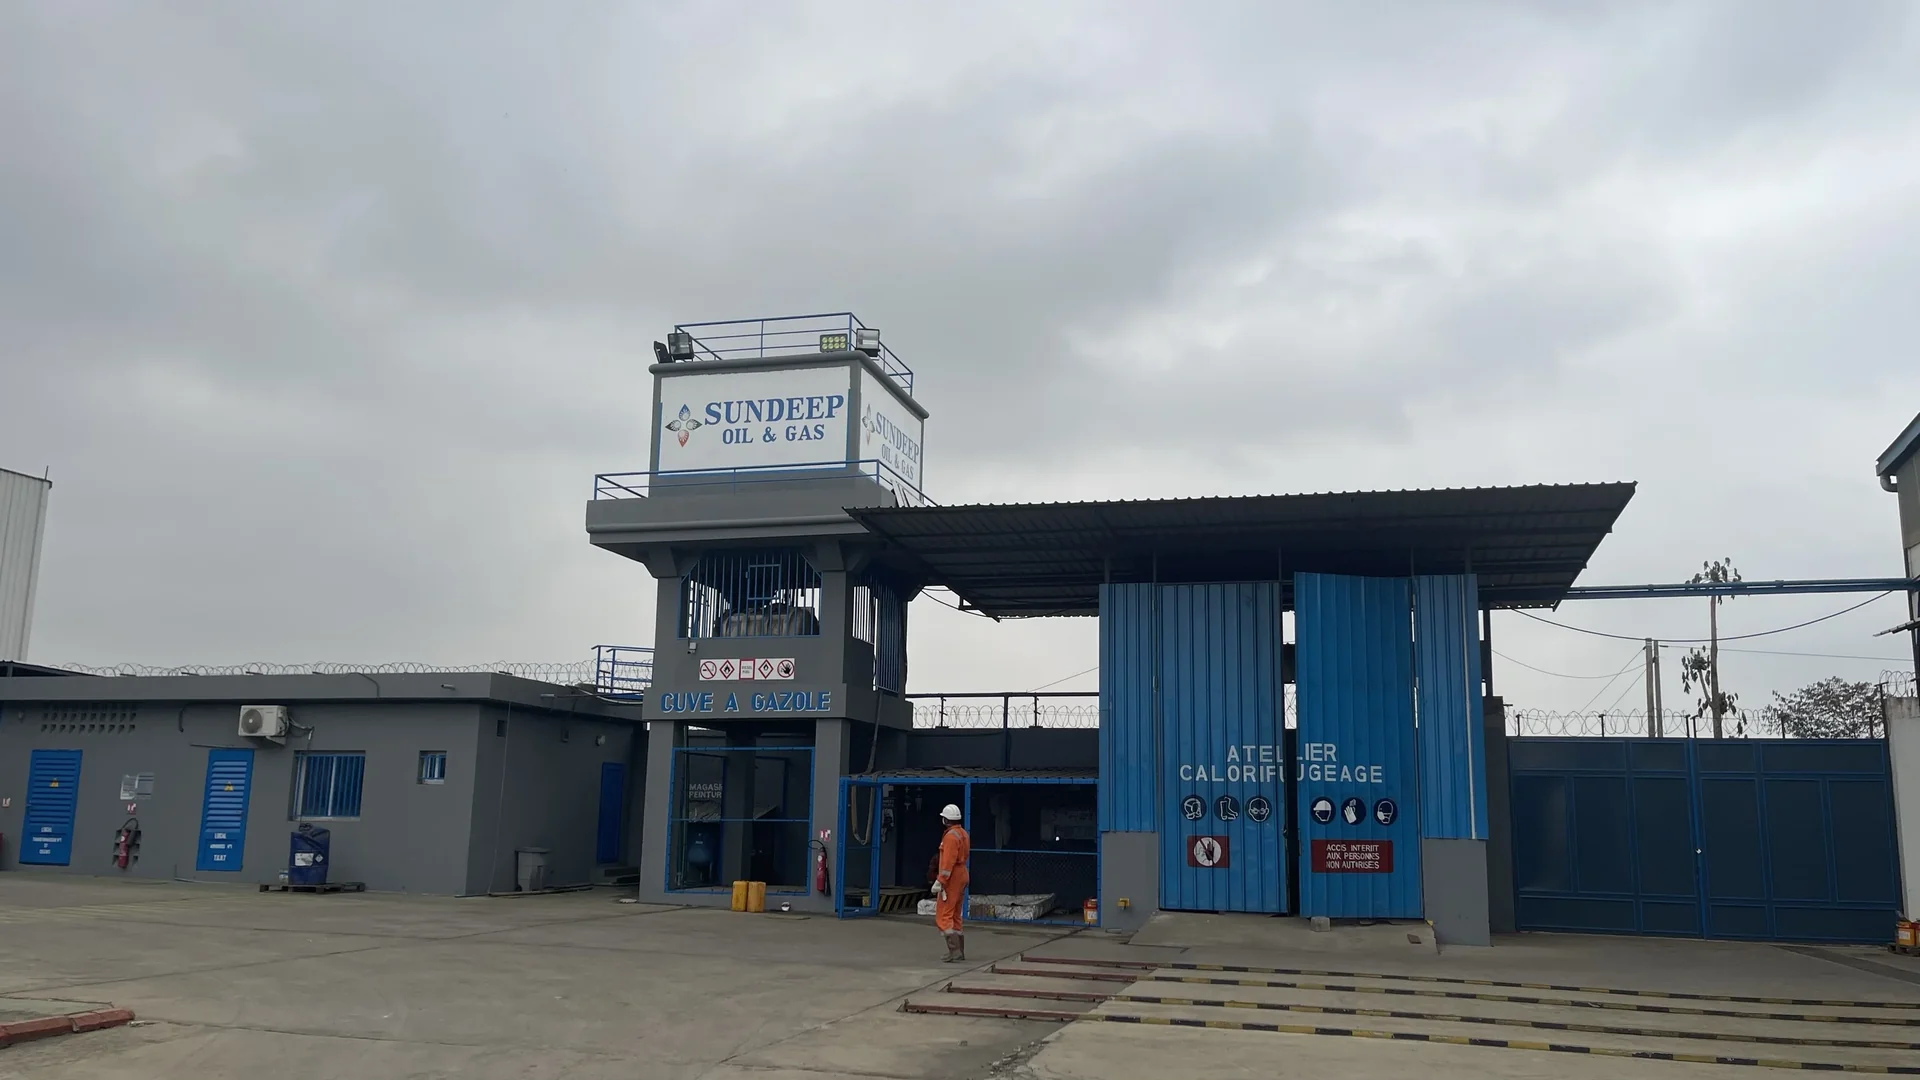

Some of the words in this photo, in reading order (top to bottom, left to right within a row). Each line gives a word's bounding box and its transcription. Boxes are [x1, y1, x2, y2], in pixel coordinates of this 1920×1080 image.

[704, 394, 845, 426] SUNDEEP
[722, 427, 754, 444] OIL
[762, 426, 777, 443] &
[785, 423, 825, 441] GAS
[876, 411, 920, 464] SUNDEEP
[881, 443, 892, 464] OIL
[901, 460, 914, 480] GAS
[660, 691, 714, 713] CUVE
[723, 692, 740, 712] A
[751, 691, 832, 712] GAZOLE
[1226, 743, 1337, 763] ATELIER
[1179, 764, 1383, 783] CALORIFUGEAGE
[689, 783, 723, 791] MAGASI
[689, 791, 722, 799] PEINTUR
[1326, 852, 1341, 860] AUX
[1326, 861, 1340, 869] NON
